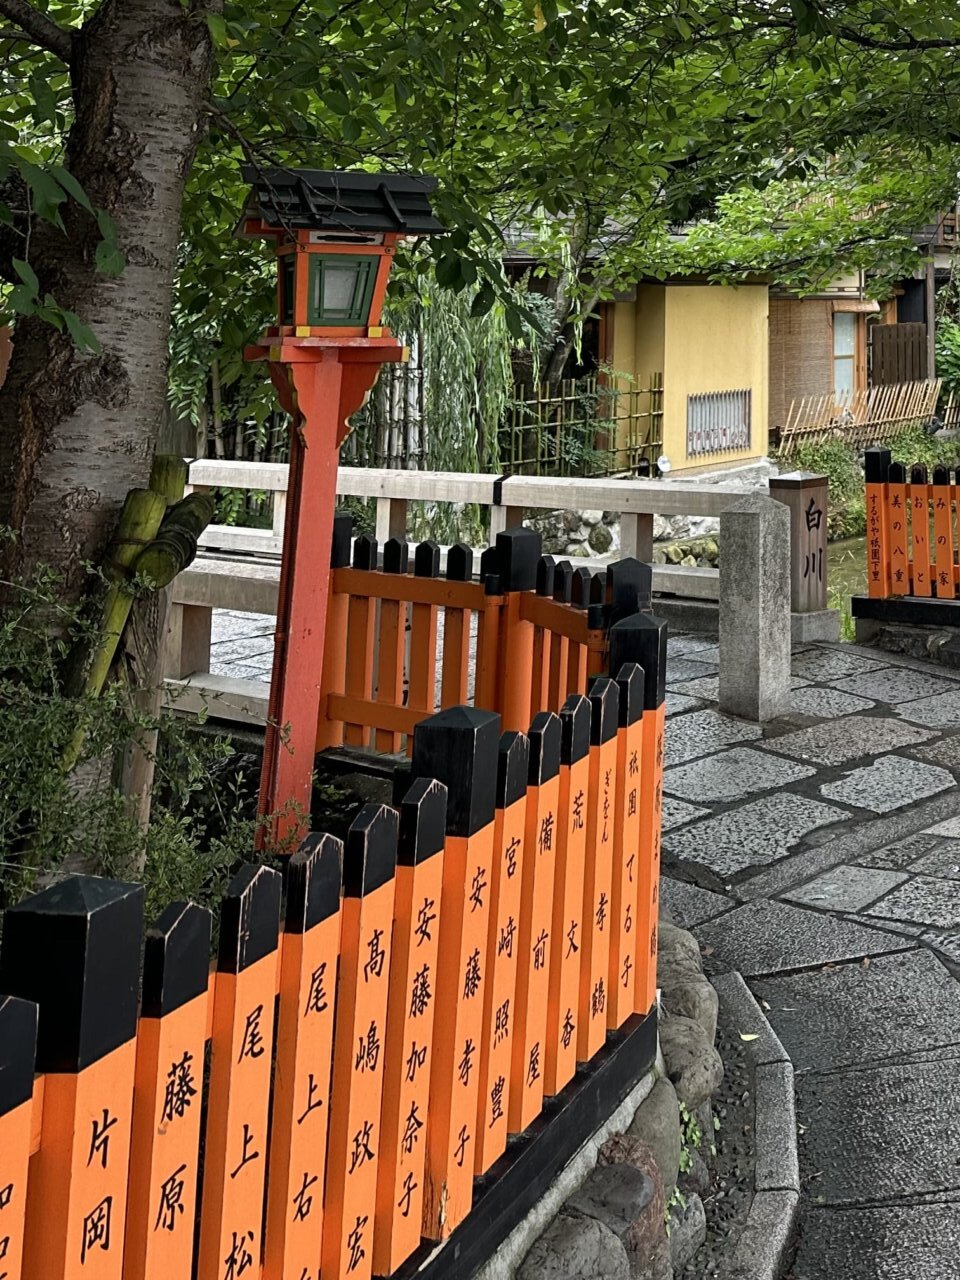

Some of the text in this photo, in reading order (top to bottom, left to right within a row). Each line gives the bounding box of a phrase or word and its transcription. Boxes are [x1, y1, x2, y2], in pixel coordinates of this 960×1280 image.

[804, 497, 823, 582] 白川
[891, 494, 905, 583] 美の八重
[914, 496, 925, 582] おいと
[936, 497, 949, 586] みの家
[454, 866, 487, 1167] 安藤孝子
[526, 811, 554, 1088] 備前屋
[154, 1051, 198, 1232] 藤原
[293, 962, 329, 1280] 尾上右
[398, 897, 436, 1217] 安藤加奈子
[80, 1108, 119, 1265] 片岡
